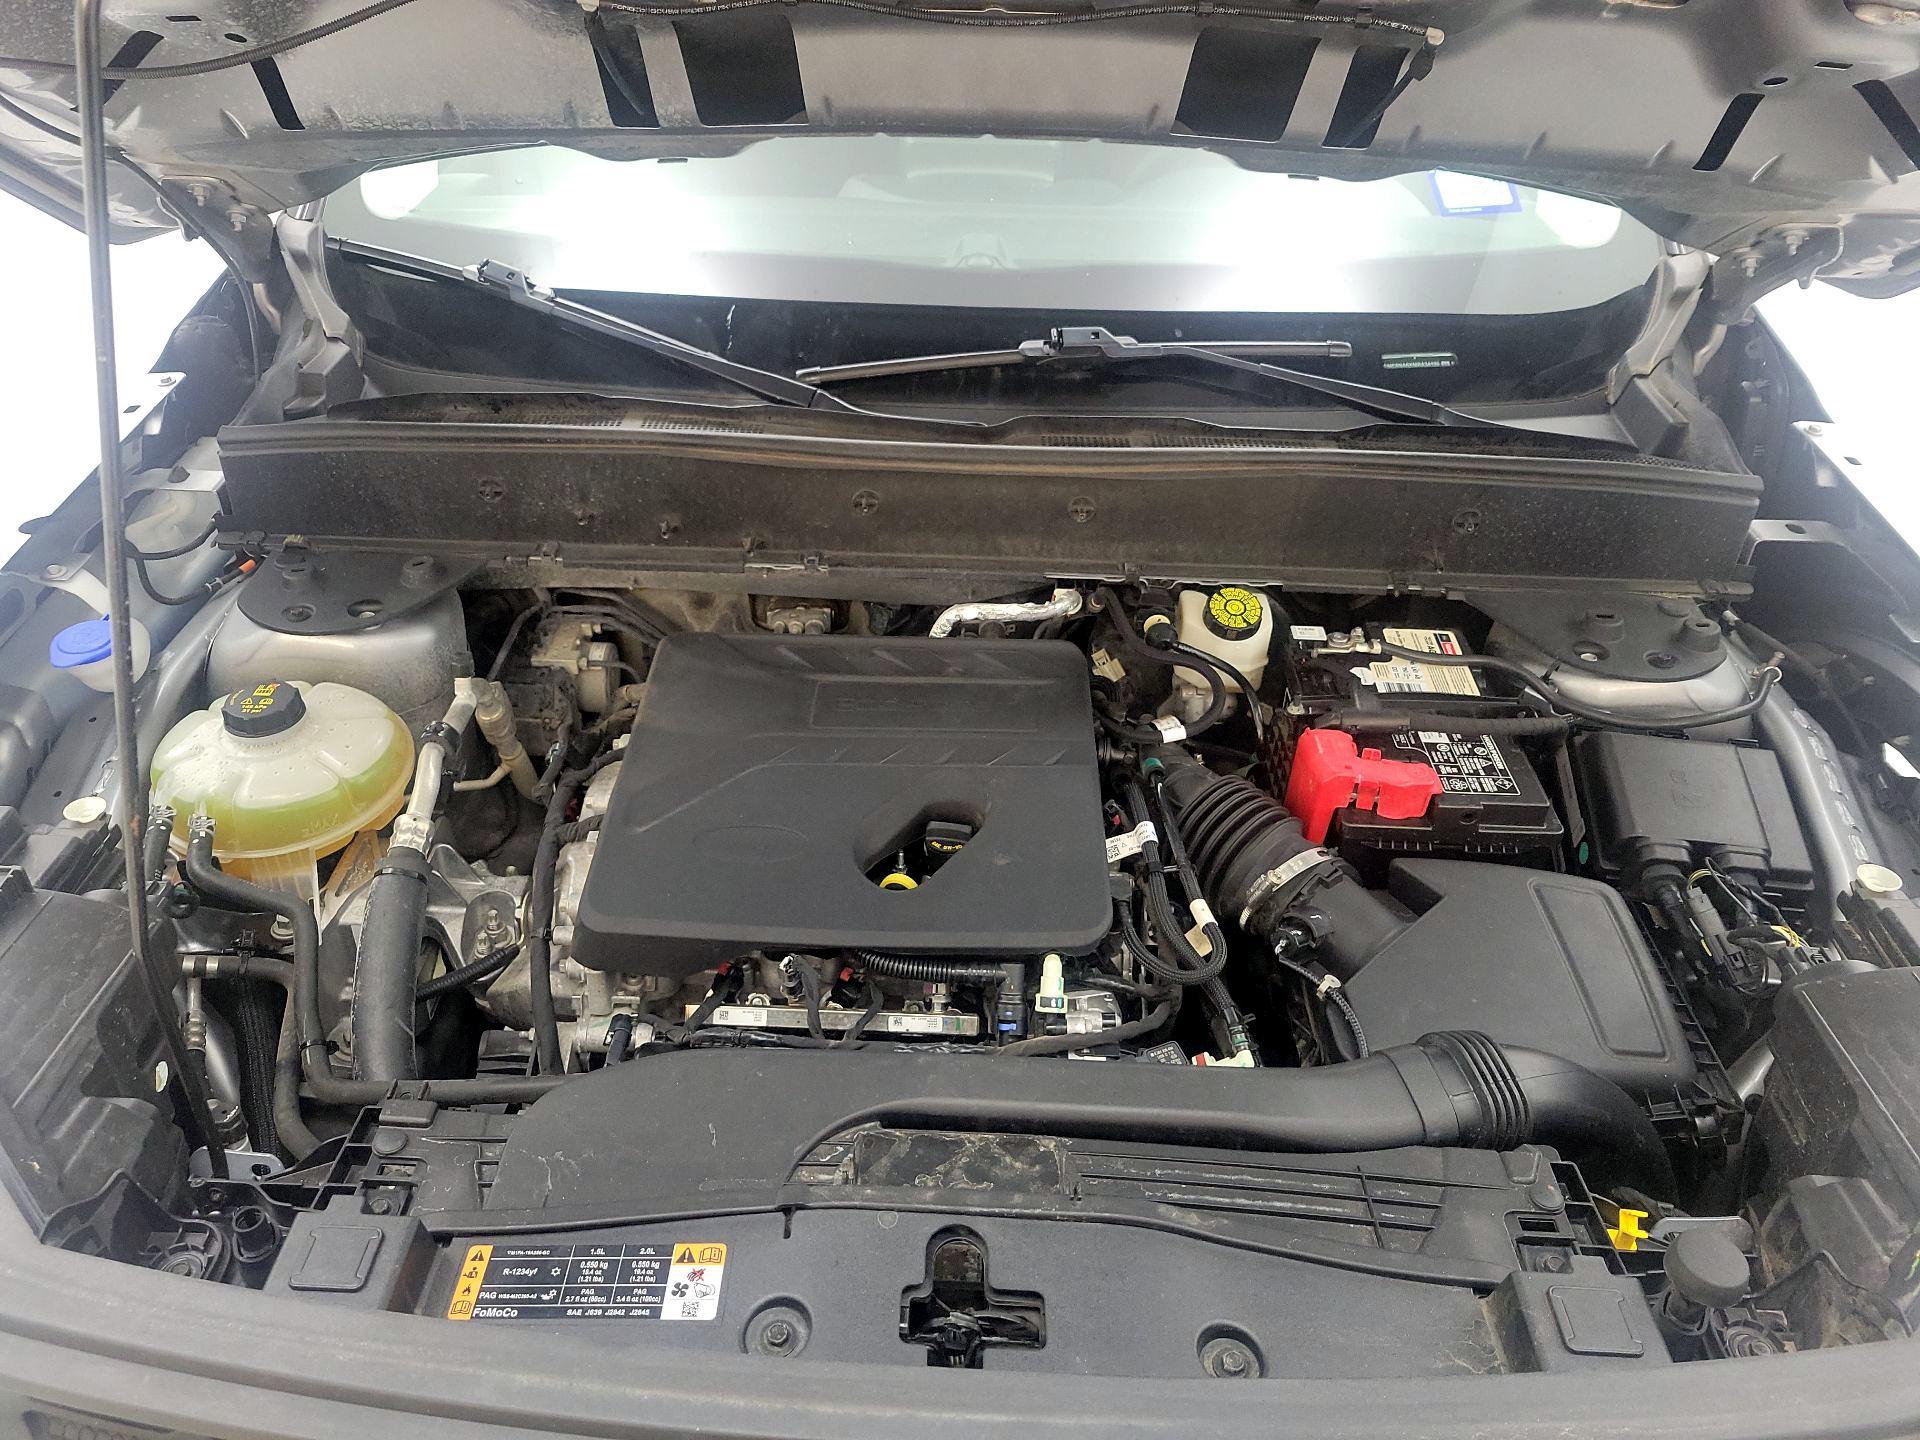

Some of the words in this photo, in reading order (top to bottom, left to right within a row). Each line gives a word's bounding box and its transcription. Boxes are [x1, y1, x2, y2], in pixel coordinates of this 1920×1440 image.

[639, 1247, 656, 1255] 2.0L
[599, 1260, 609, 1270] kg
[651, 1260, 661, 1270] kg
[502, 1267, 539, 1277] R-1234yf
[478, 1291, 498, 1300] PAG
[472, 1307, 519, 1317] FoMoCo
[566, 1308, 583, 1316] SAE
